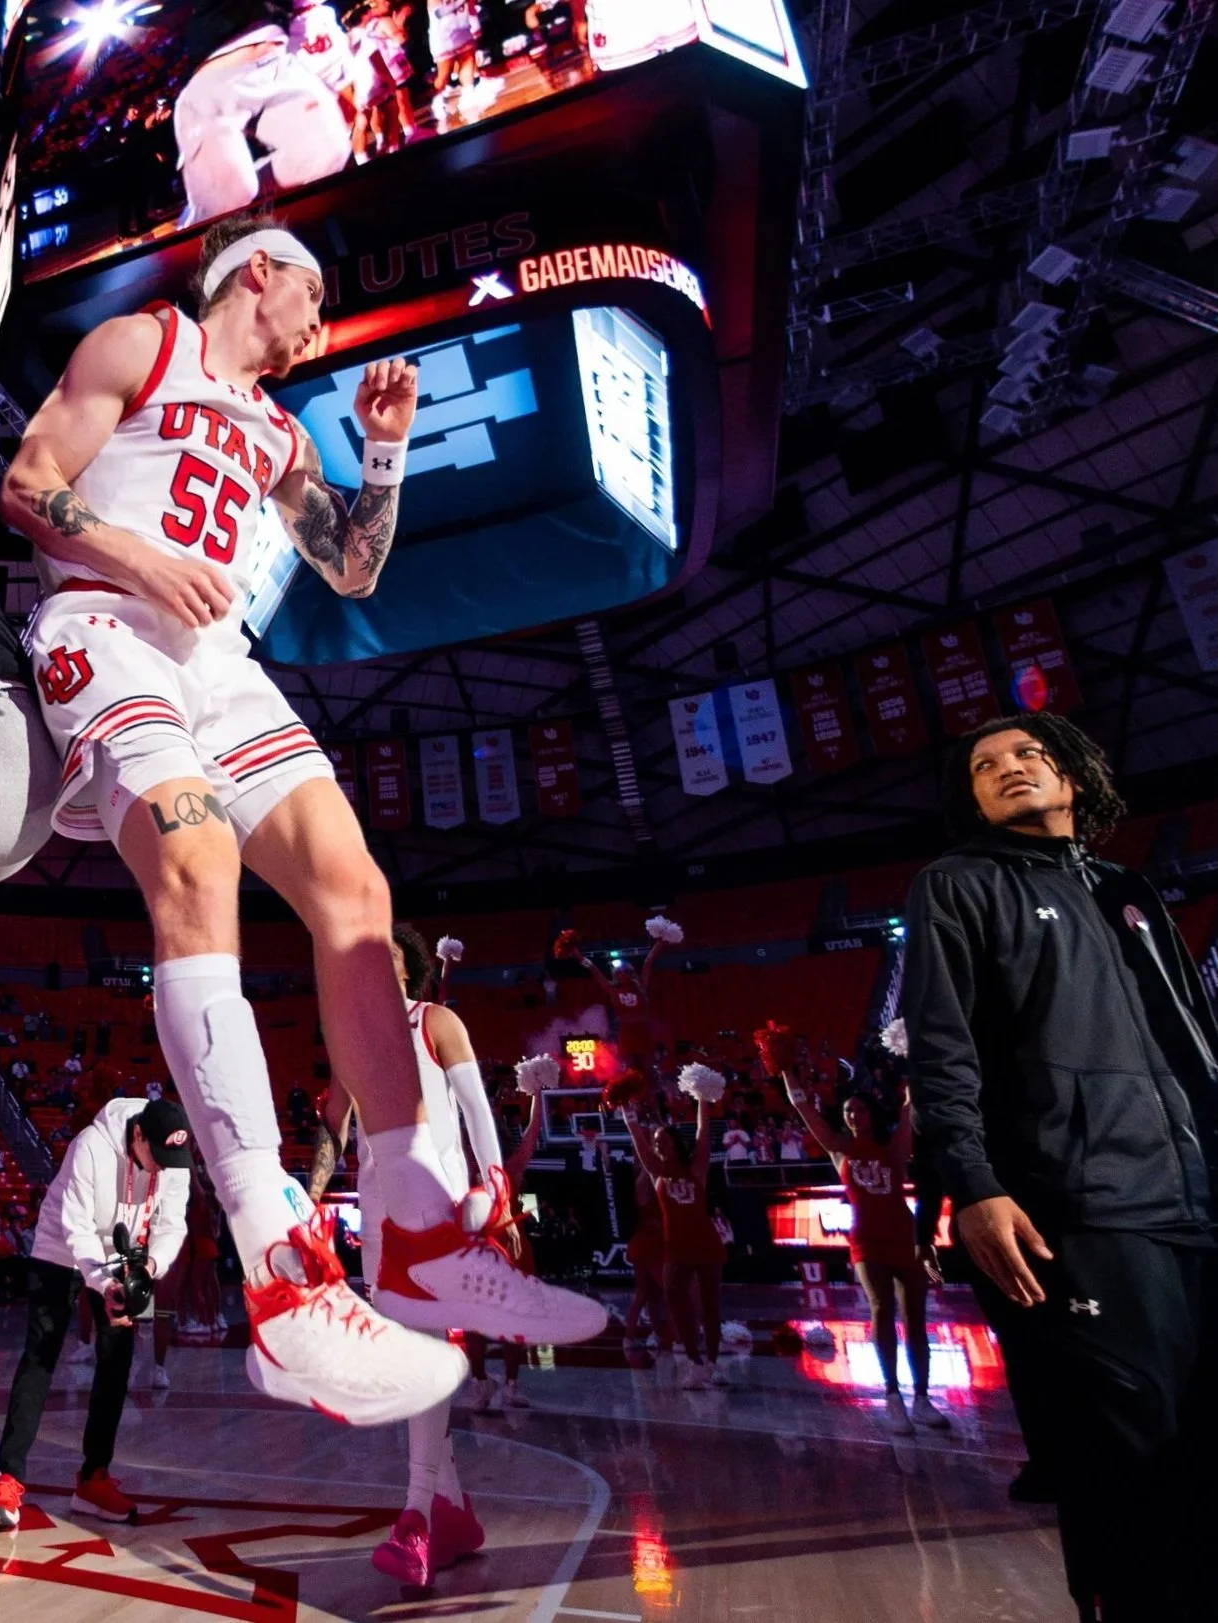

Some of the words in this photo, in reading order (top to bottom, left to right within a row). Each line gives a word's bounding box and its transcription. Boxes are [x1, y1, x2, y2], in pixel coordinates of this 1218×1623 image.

[359, 211, 536, 293] UTES
[159, 402, 273, 499] UTAH
[161, 450, 251, 565] 55
[745, 731, 776, 746] 1947
[685, 744, 715, 758] 1944
[566, 1040, 596, 1053] 20:00
[572, 1052, 595, 1071] 30
